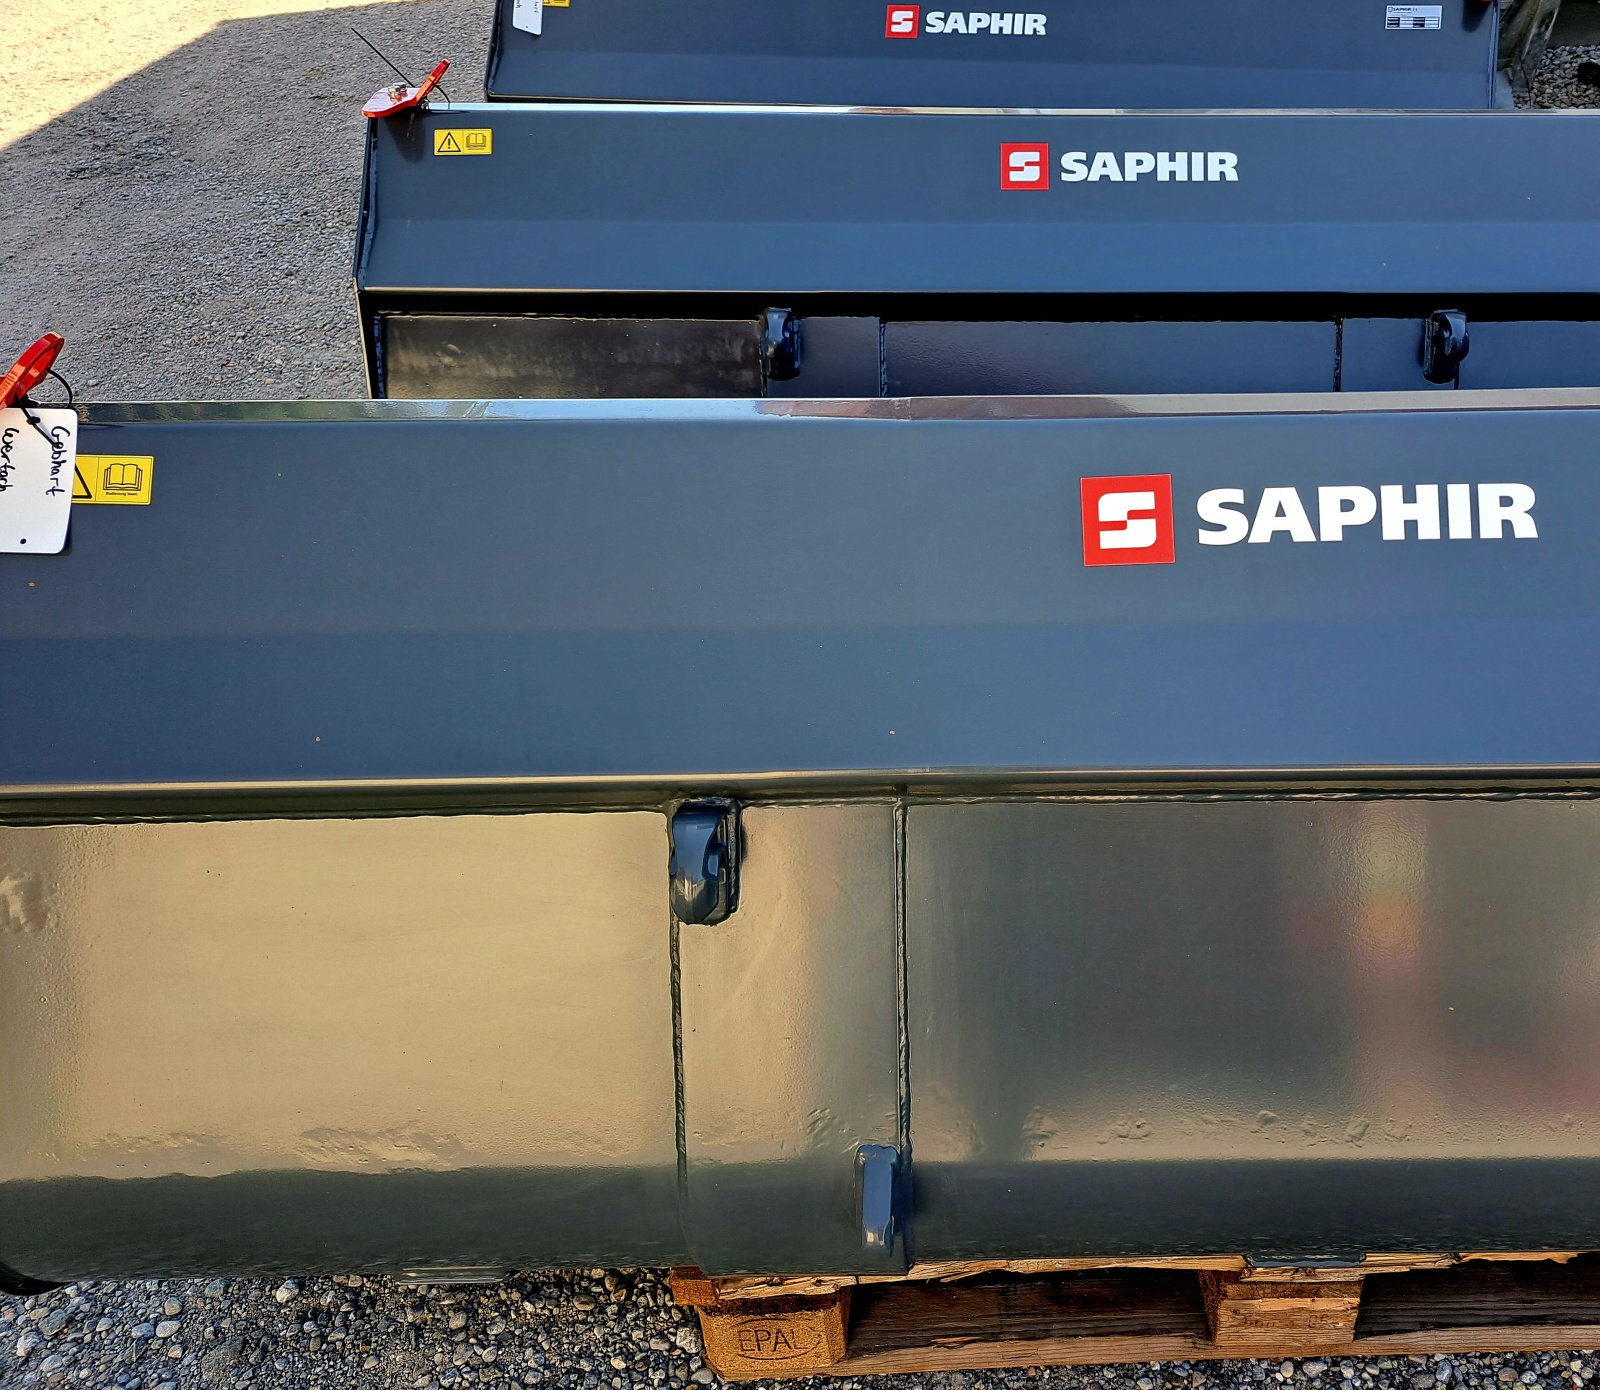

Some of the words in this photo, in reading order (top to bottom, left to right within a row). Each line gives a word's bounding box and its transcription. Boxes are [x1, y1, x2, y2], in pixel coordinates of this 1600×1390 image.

[925, 11, 1047, 36] SAPHIR
[1060, 151, 1239, 183] SAPHIR
[1196, 482, 1539, 546] SAPHIR
